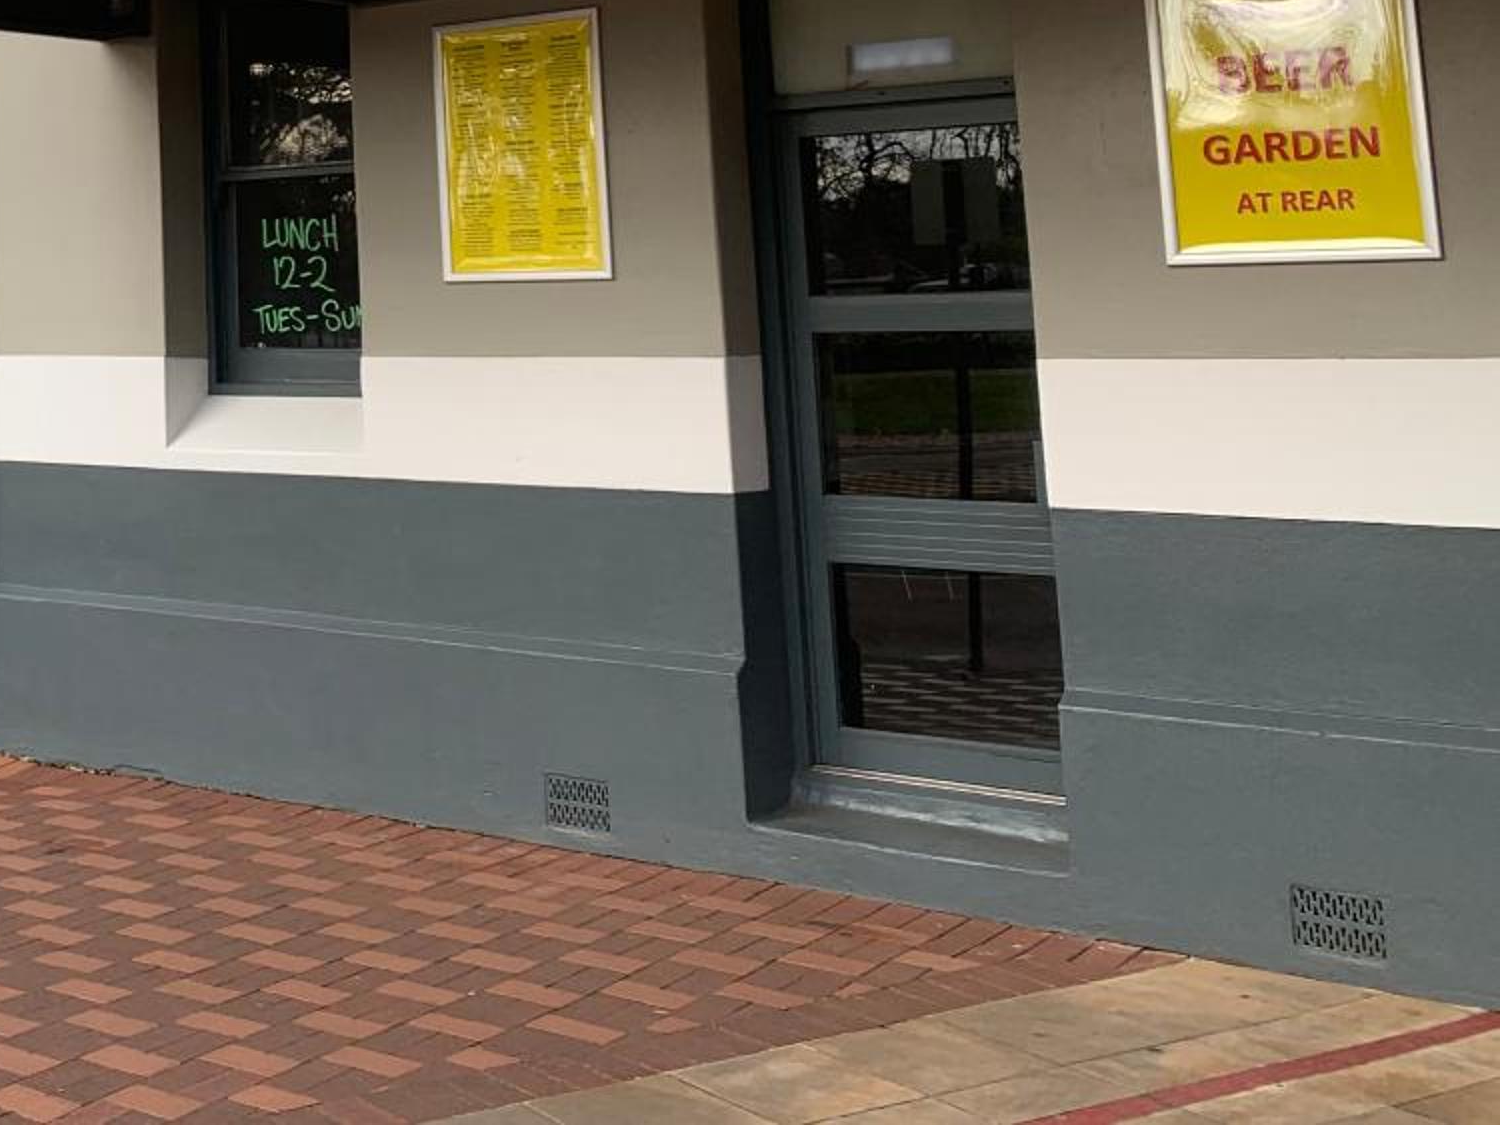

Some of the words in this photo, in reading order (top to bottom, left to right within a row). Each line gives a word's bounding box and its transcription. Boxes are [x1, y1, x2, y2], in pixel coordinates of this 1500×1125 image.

[1217, 46, 1353, 95] BEER
[1203, 125, 1381, 166] GARDEN
[1237, 192, 1272, 214] AT
[1281, 189, 1355, 213] REAR
[261, 215, 339, 252] LUNCH
[273, 256, 336, 292] 12-2
